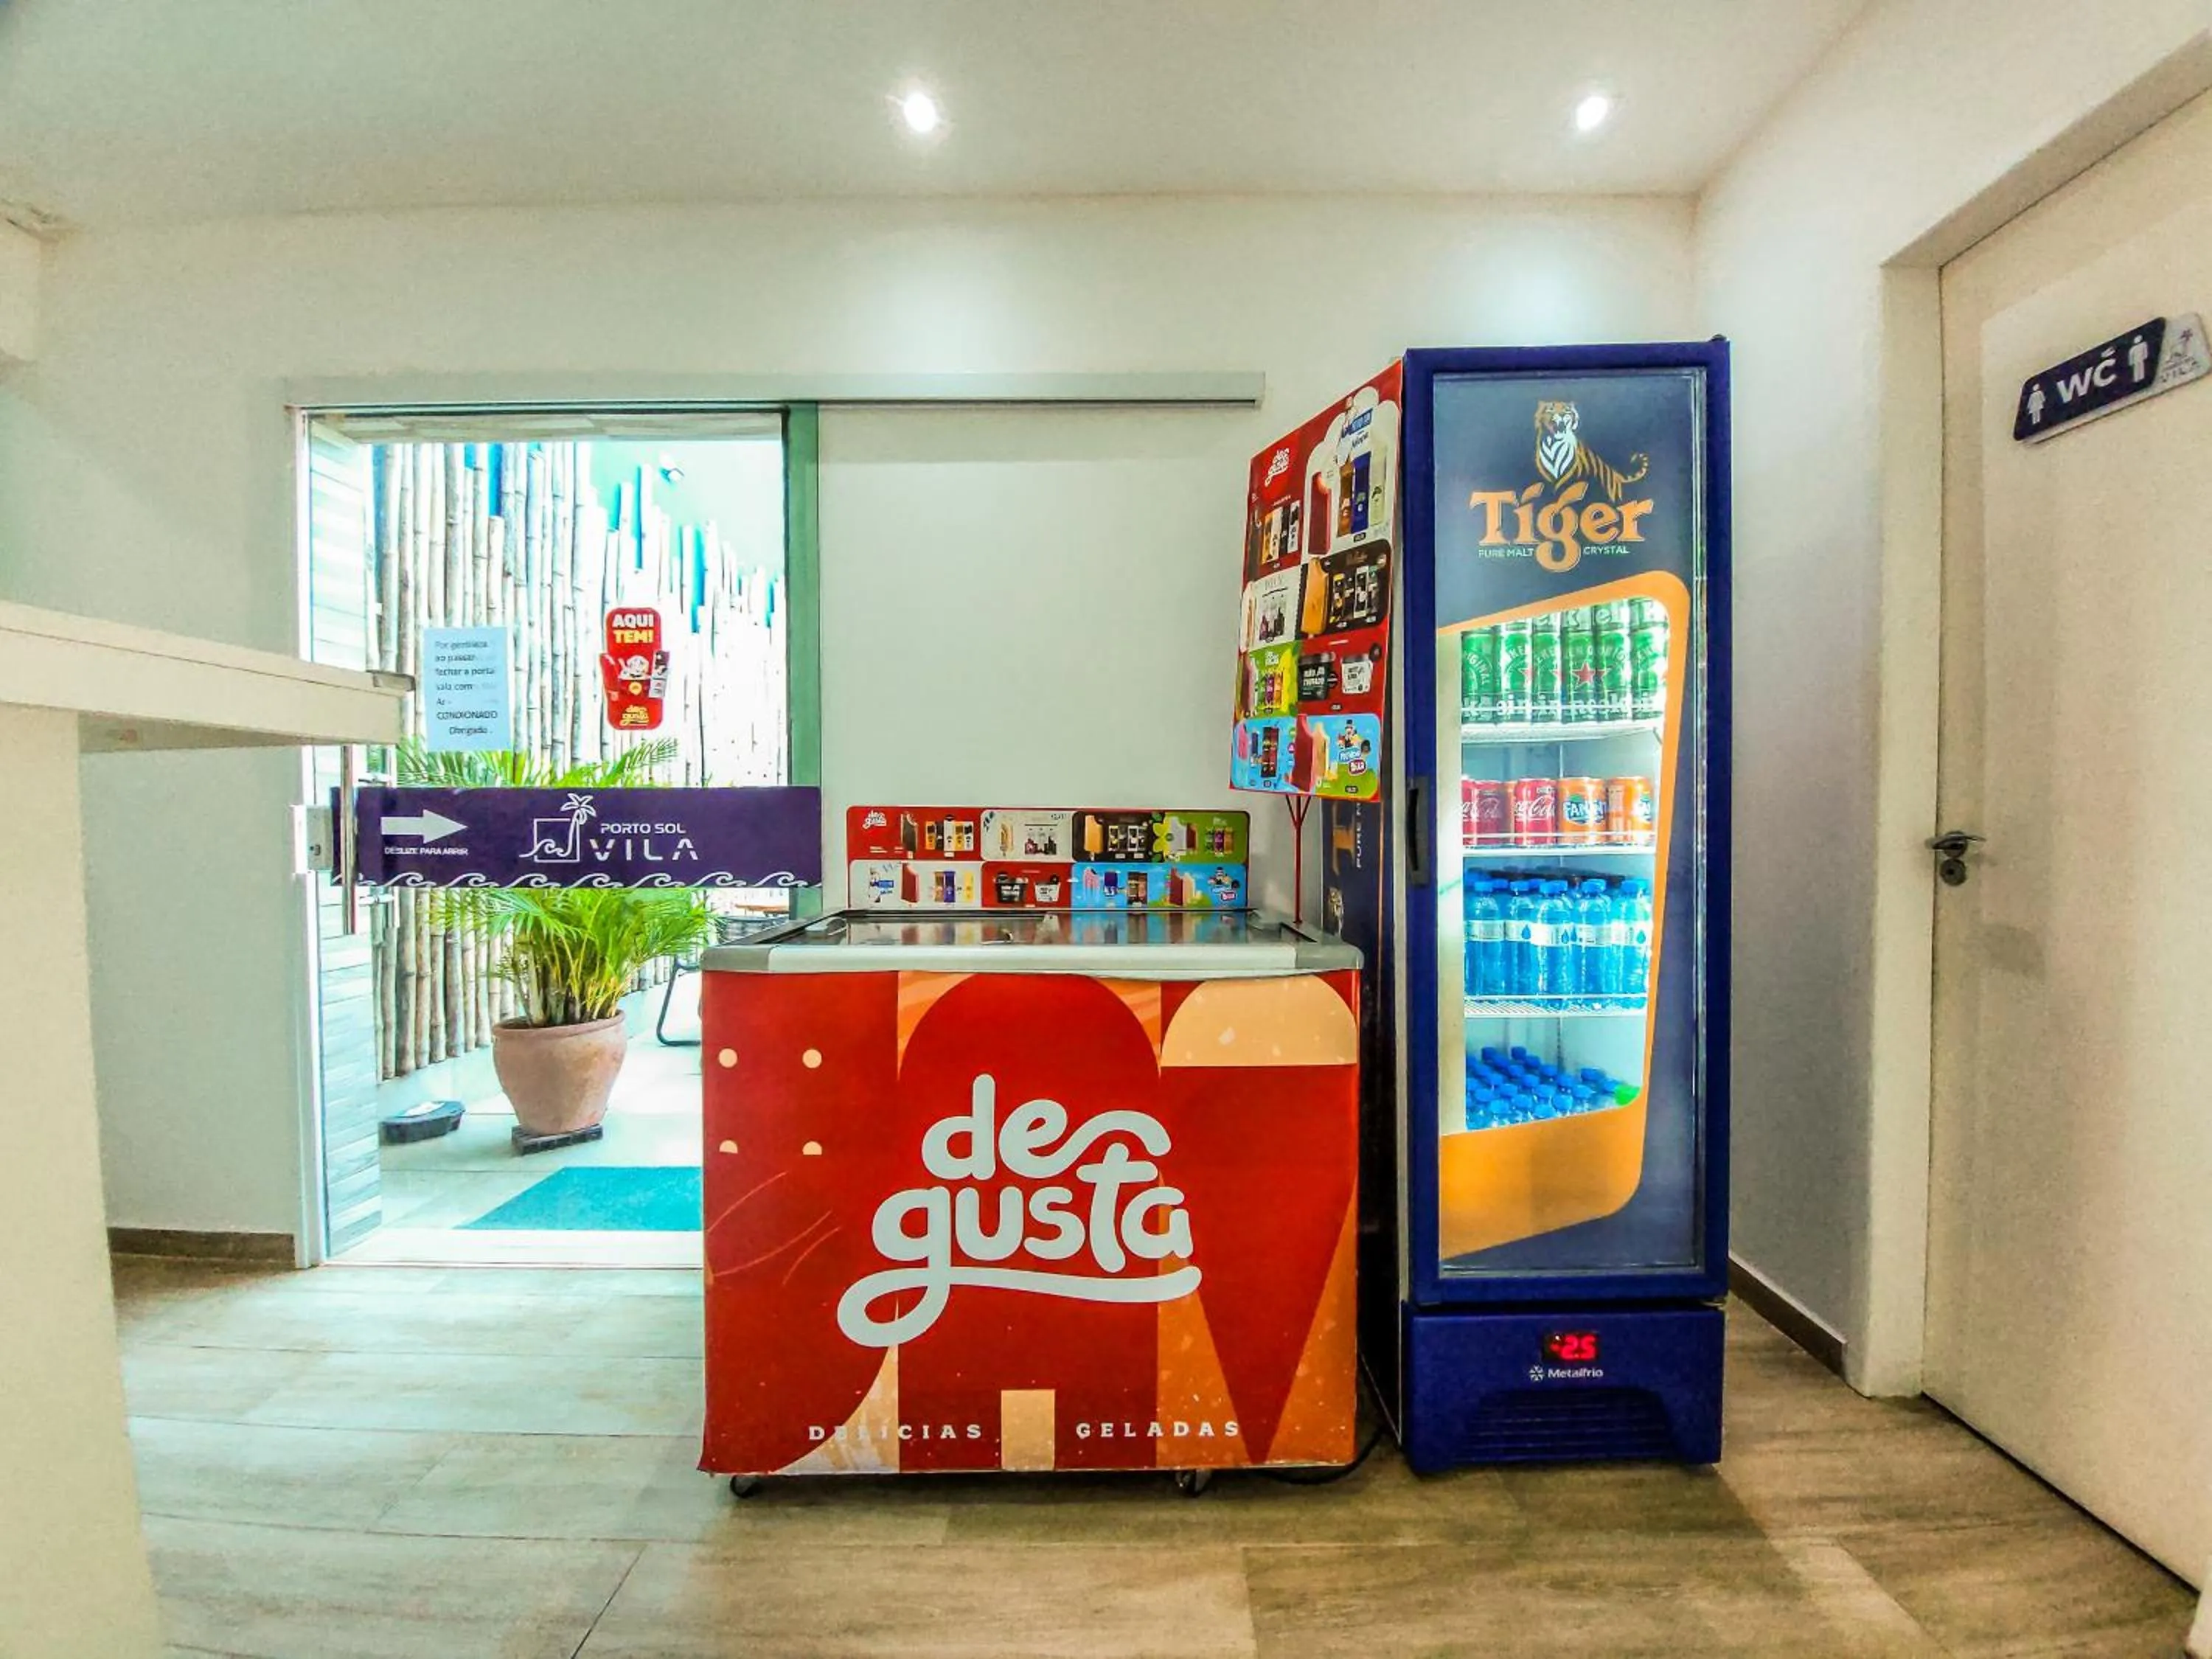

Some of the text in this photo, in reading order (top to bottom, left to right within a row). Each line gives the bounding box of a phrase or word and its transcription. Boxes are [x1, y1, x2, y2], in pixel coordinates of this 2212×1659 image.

[2056, 358, 2117, 403] WC
[1470, 481, 1654, 573] Tiger
[1478, 545, 1630, 558] PURE MALT CRYSTAL
[612, 613, 654, 628] AQUI
[613, 629, 654, 644] TEM!
[471, 667, 495, 677] porta
[454, 683, 473, 691] com
[600, 823, 686, 834] PORTO SOL
[420, 847, 442, 855] PARA
[589, 838, 699, 861] VILA
[922, 1074, 1171, 1180] de
[837, 1142, 1203, 1347] gusta
[1548, 1368, 1604, 1379] Metalfrio
[1076, 1421, 1242, 1440] GELADAS
